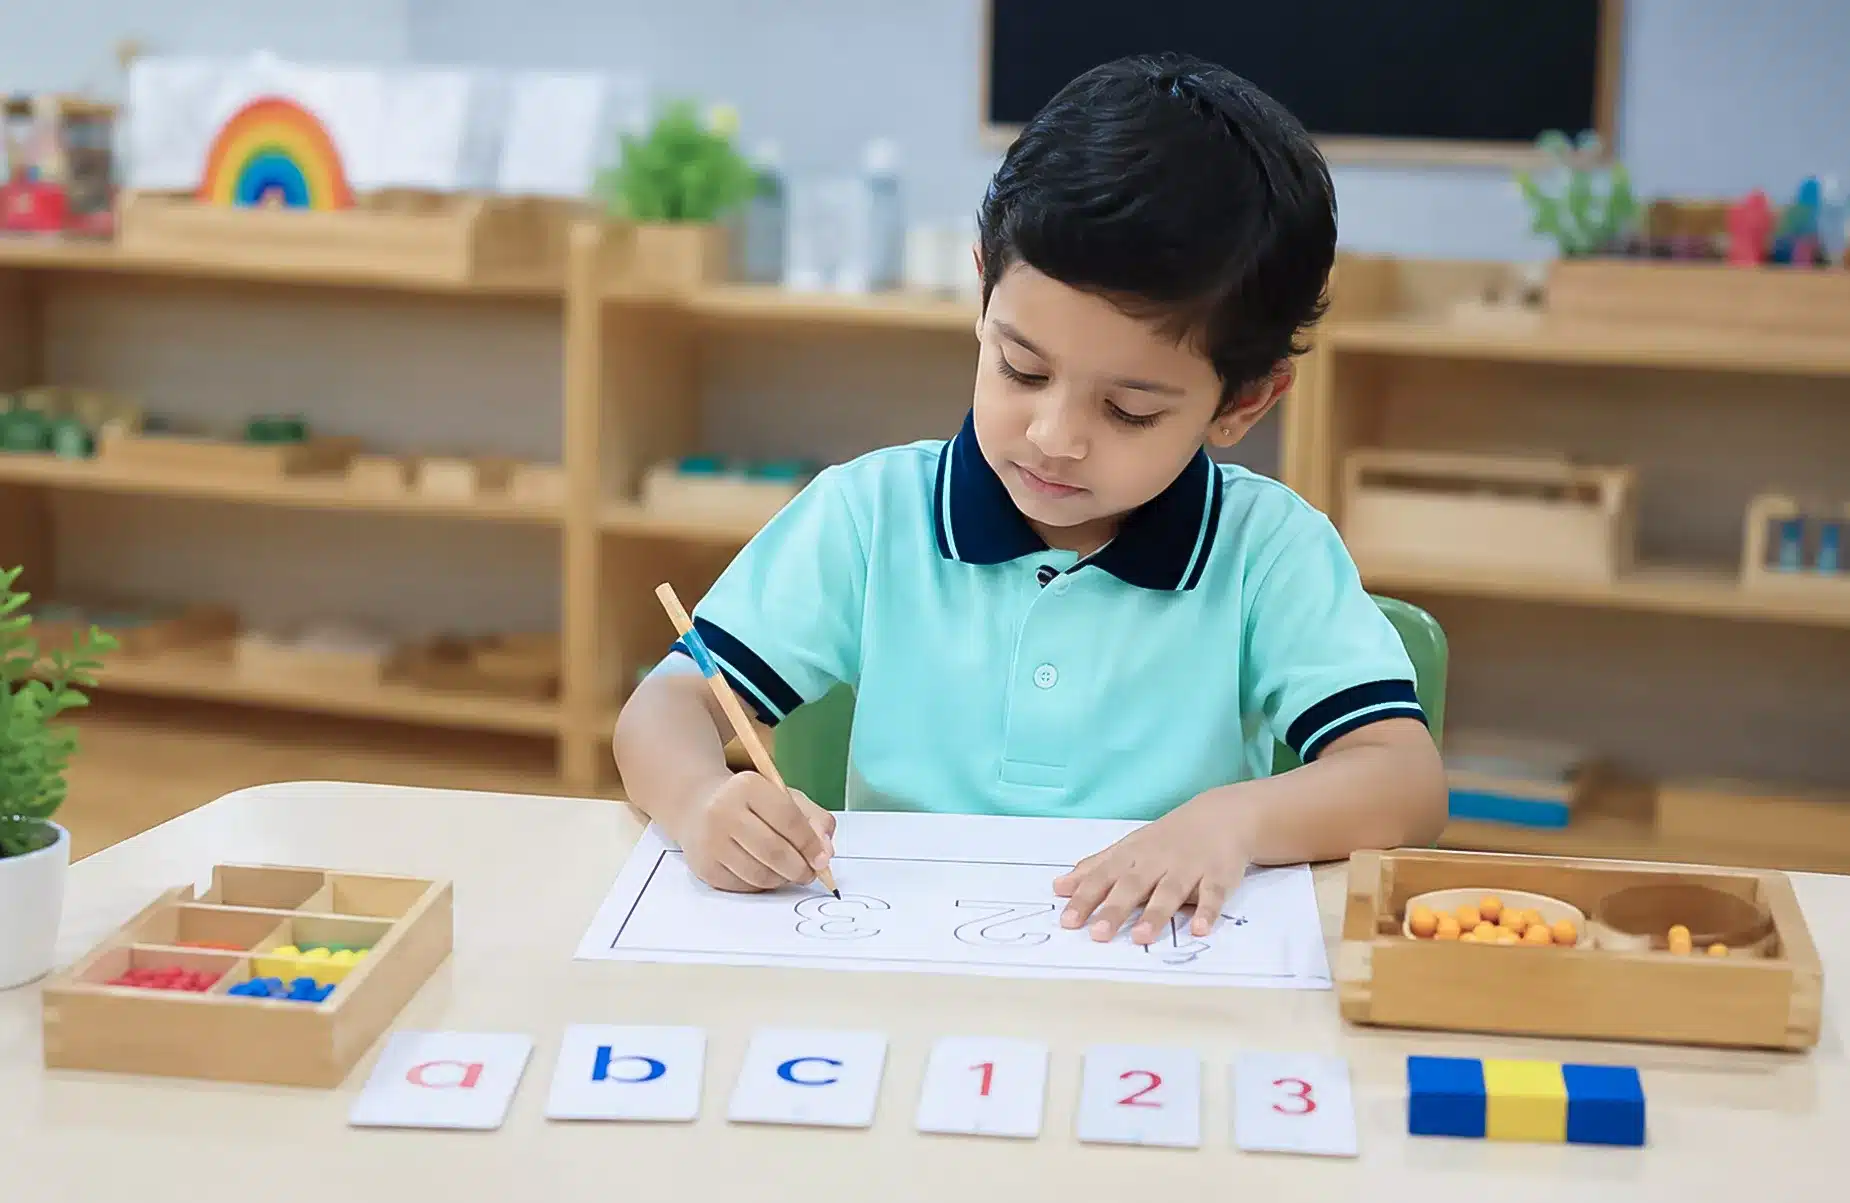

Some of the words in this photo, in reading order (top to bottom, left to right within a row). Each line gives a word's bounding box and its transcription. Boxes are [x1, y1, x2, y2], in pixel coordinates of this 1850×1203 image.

[953, 898, 1056, 947] 2
[405, 1059, 484, 1089] a
[591, 1044, 667, 1084] b
[775, 1056, 844, 1087] c
[968, 1061, 994, 1097] 1
[1116, 1069, 1163, 1108] 2
[1271, 1077, 1318, 1116] 3
